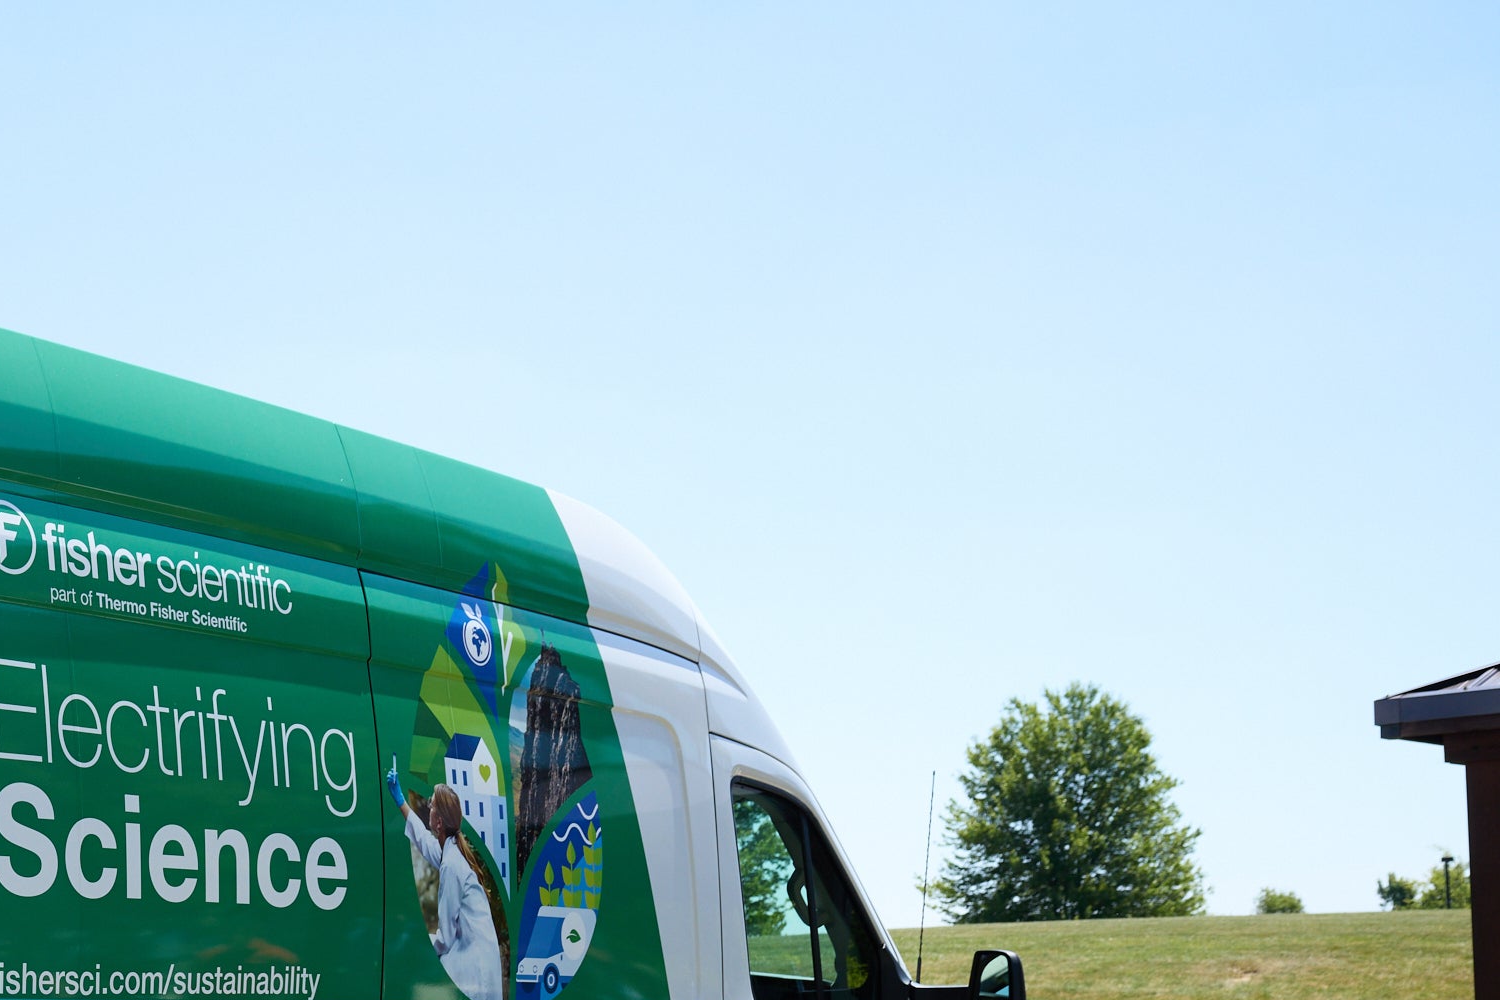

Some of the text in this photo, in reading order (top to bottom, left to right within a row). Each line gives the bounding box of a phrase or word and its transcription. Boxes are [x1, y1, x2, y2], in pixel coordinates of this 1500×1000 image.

[41, 521, 152, 587] fisher
[156, 551, 293, 615] scientific
[50, 586, 248, 633] part of Thermo Fisher Scientific
